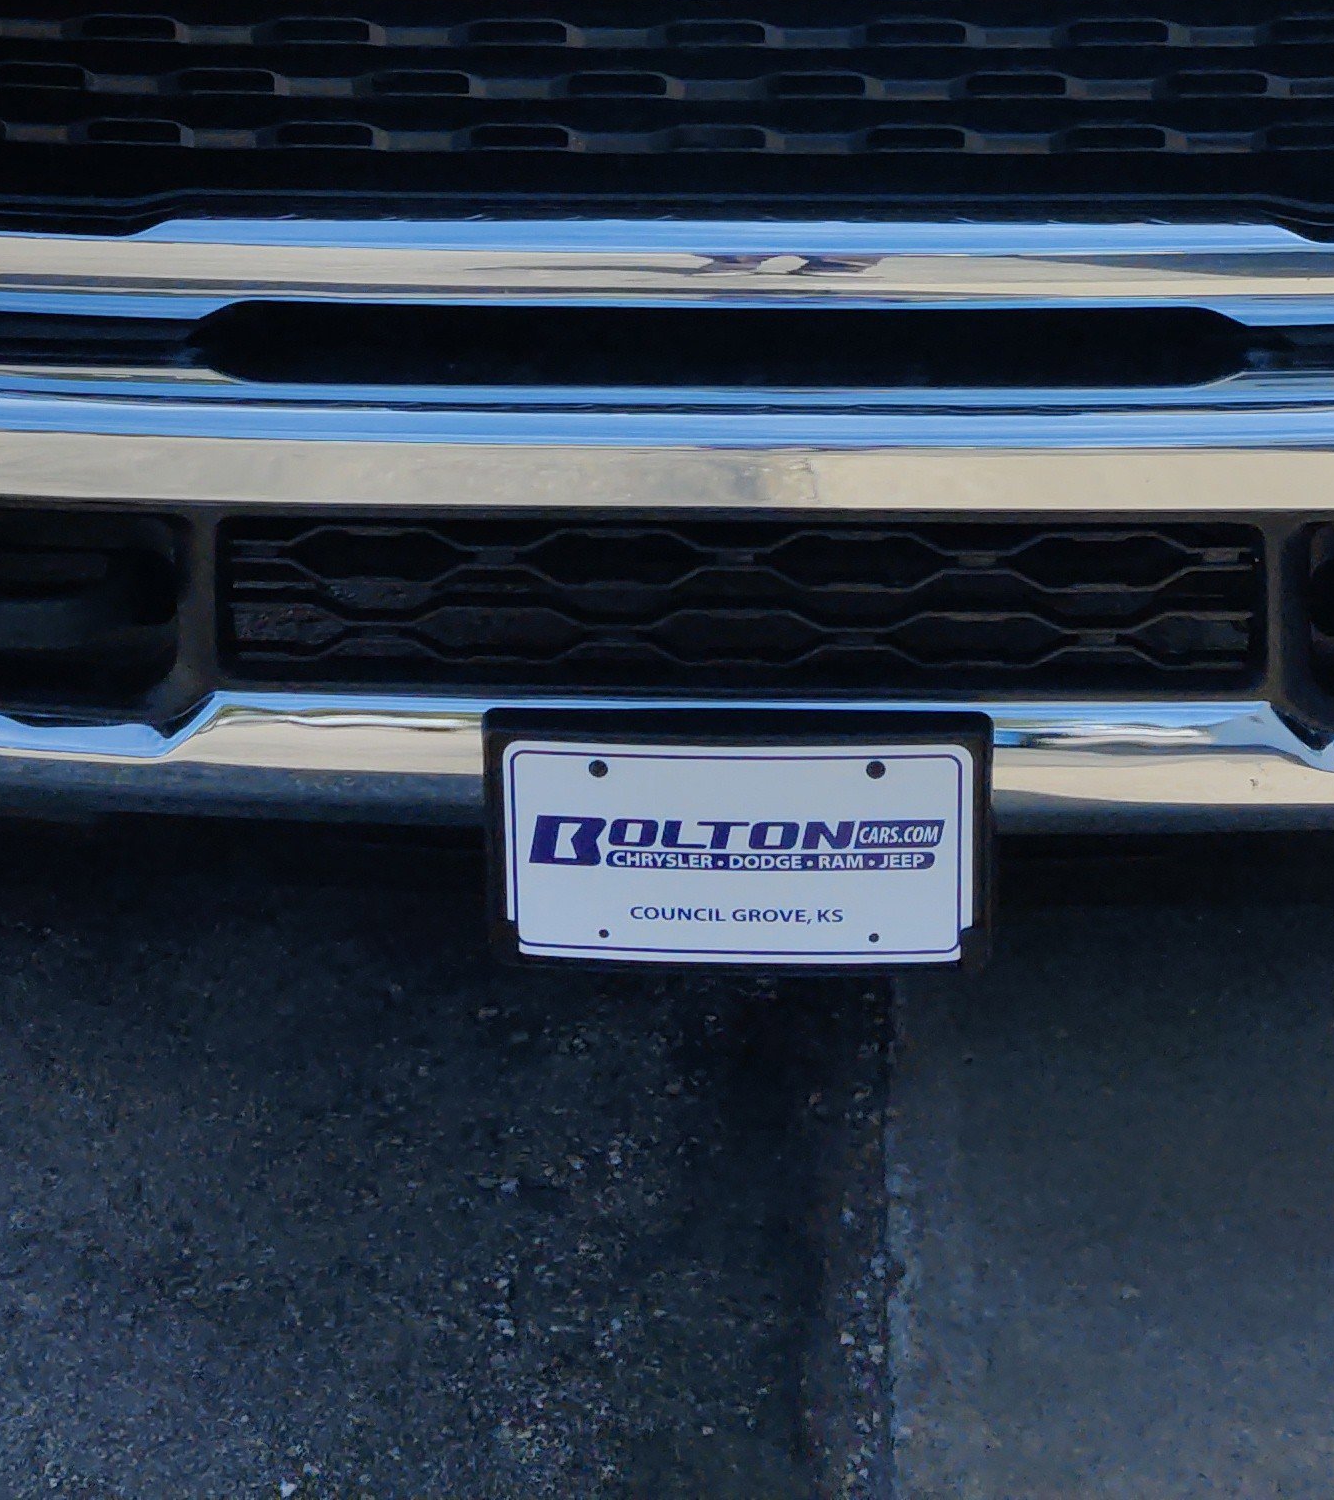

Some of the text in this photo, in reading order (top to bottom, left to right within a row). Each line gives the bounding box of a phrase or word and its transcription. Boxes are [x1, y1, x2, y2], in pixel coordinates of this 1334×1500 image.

[529, 815, 940, 866] BOLTON CARS.COM
[612, 851, 925, 870] CHRYSLER DODGE RAM JEEP
[630, 906, 844, 925] COUNCIL GROVE, KS
